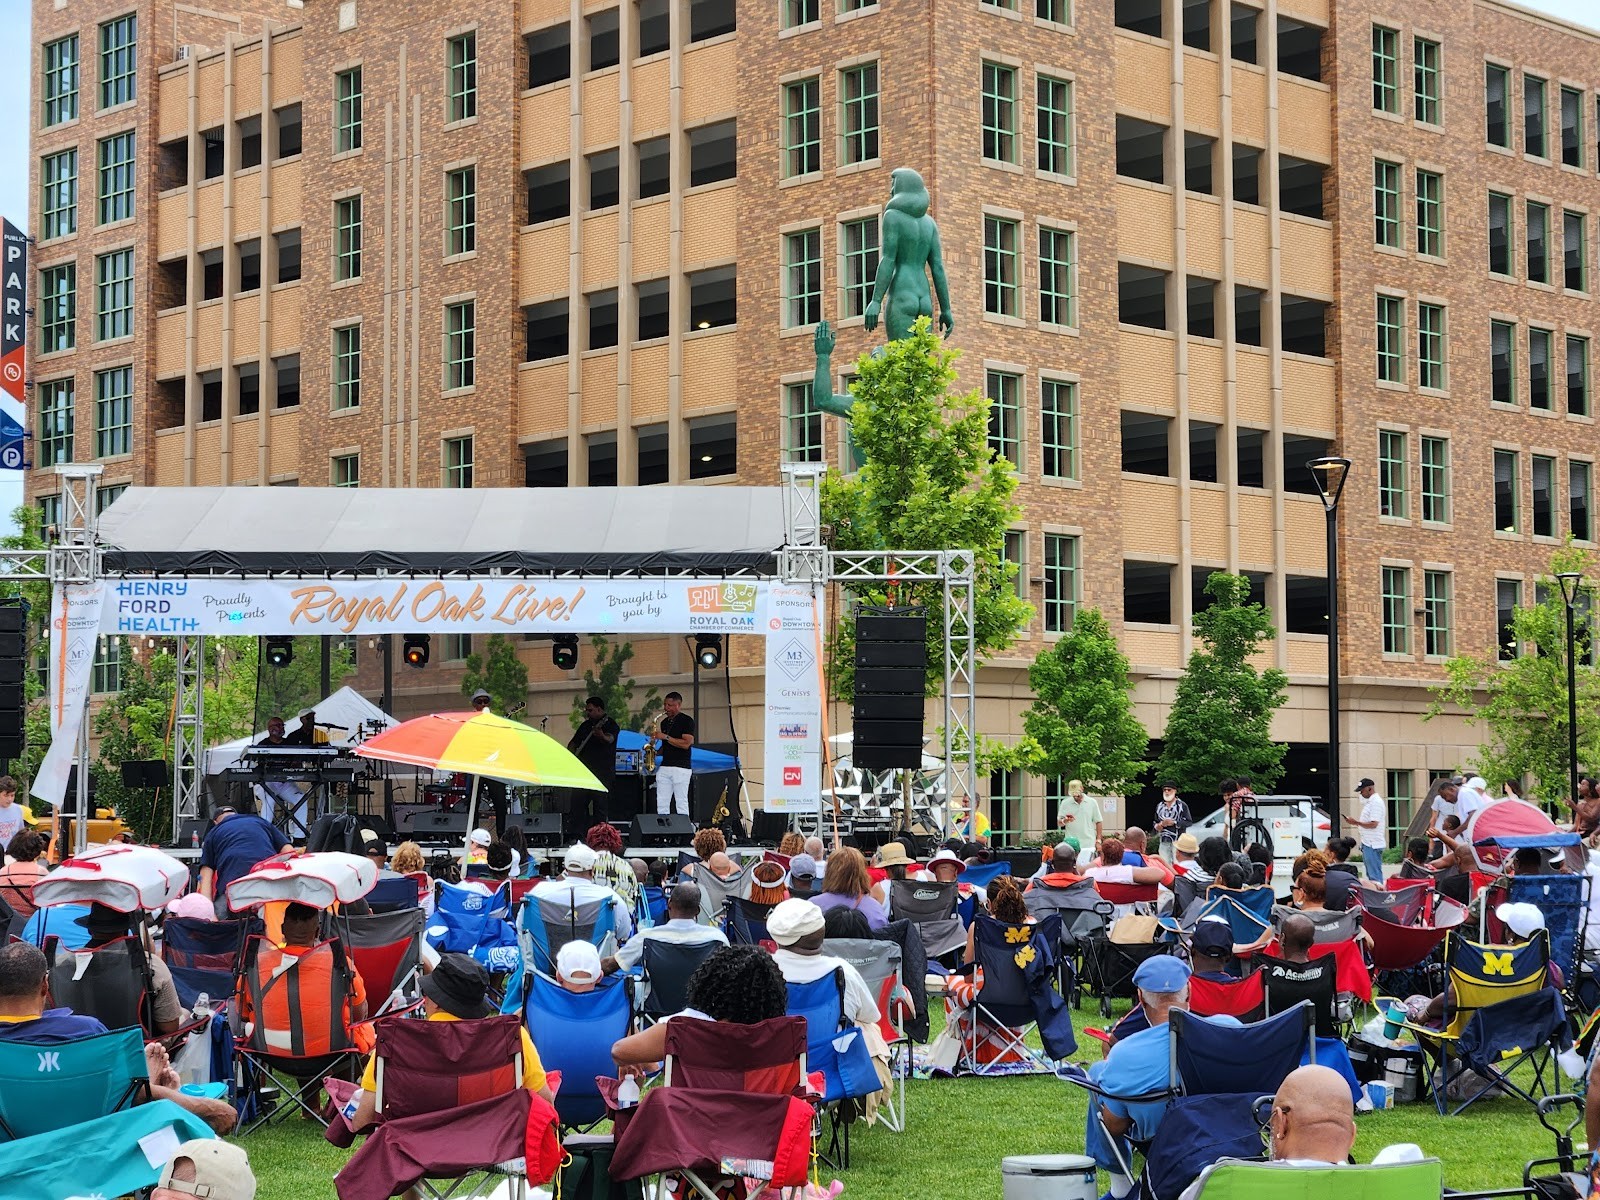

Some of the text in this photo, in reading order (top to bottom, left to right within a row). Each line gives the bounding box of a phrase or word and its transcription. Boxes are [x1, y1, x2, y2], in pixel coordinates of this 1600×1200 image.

[4, 234, 25, 243] PUBLIC
[5, 246, 22, 341] PARK
[7, 451, 17, 463] P
[116, 582, 187, 596] HENRY
[203, 592, 252, 607] Proudly
[606, 589, 668, 607] Brought to
[119, 600, 171, 614] FORD
[216, 607, 266, 621] Presents
[290, 581, 586, 634] Royal Oak Live!
[623, 604, 662, 621] you by
[118, 617, 200, 631] HEALTH
[689, 616, 755, 626] ROYAL OAK
[787, 651, 802, 661] M3
[784, 772, 801, 780] CN
[1004, 925, 1032, 944] M
[1482, 951, 1515, 976] M
[1285, 966, 1323, 980] Academy
